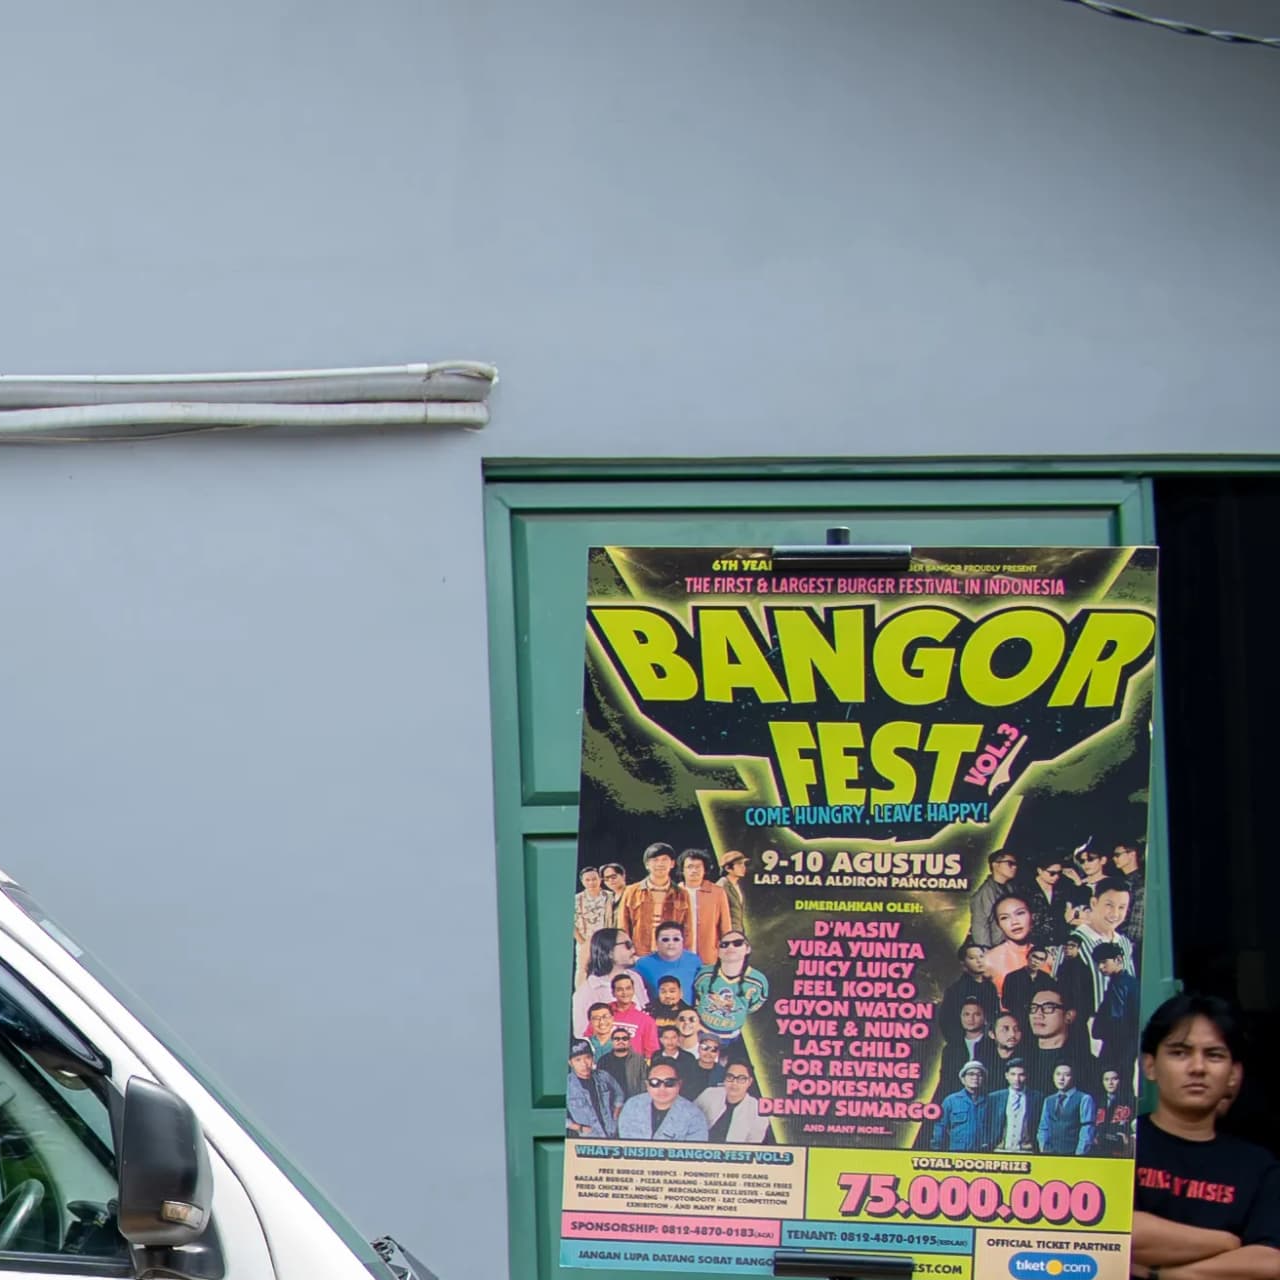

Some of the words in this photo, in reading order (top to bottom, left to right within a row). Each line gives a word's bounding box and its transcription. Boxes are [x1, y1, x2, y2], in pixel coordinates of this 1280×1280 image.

[712, 560, 738, 571] 6TH
[741, 560, 772, 571] YEA
[926, 564, 961, 573] BANGOR
[964, 564, 1000, 573] PROUDLY
[1003, 564, 1038, 573] PRESENT
[685, 577, 710, 593] THE
[714, 577, 753, 593] FIRST
[757, 577, 768, 593] &
[772, 577, 834, 593] LARGEST
[837, 577, 895, 594] BURGER
[899, 578, 961, 594] FESTIVAL
[965, 578, 980, 594] IN
[984, 579, 1065, 595] INDONESIA
[591, 608, 1156, 708] BANGOR
[964, 723, 1020, 787] VOL.3
[769, 721, 984, 813] FEST
[745, 808, 790, 826] COME
[795, 806, 871, 825] HUNGRY,
[875, 803, 922, 823] LEAVE
[927, 802, 989, 822] HAPPY!
[761, 850, 824, 873] 9-10
[831, 852, 961, 875] AGUSTUS
[754, 874, 782, 886] LAP.
[785, 875, 821, 887] BOLA
[825, 875, 888, 888] ALDIRON
[891, 877, 968, 889] PANCORAN
[795, 900, 883, 912] DIMERIAHKAN
[886, 902, 923, 913] OLEH:
[815, 921, 900, 938] D'MASIV
[787, 940, 843, 957] YURA
[848, 941, 925, 959] YUNITA
[796, 960, 851, 977] JUICY
[856, 961, 915, 979] LUICY
[793, 980, 836, 996] FEEL
[842, 981, 915, 999] KOPLO
[774, 1000, 849, 1017] GUYON
[855, 1001, 932, 1019] WATON
[776, 1019, 838, 1036] YOVIE
[843, 1021, 858, 1037] &
[865, 1022, 929, 1039] NUNO
[793, 1039, 843, 1056] LAST
[849, 1041, 911, 1058] CHILD
[782, 1059, 823, 1076] FOR
[829, 1060, 921, 1079] REVENGE
[787, 1079, 914, 1098] PODKESMAS
[758, 1098, 830, 1116] DENNY
[835, 1100, 941, 1120] SUMARGO
[803, 1124, 825, 1133] AND
[827, 1124, 855, 1134] MANY
[576, 1145, 620, 1157] WHAT'S
[623, 1146, 665, 1158] INSIDE
[668, 1148, 721, 1160] BANGOR
[724, 1150, 752, 1161] FEST
[912, 1158, 952, 1169] TOTAL
[955, 1159, 1030, 1172] DOORPRIZE
[664, 1195, 716, 1203] PHOTOBOOTH
[838, 1173, 1104, 1224] 75.000.000
[570, 1221, 658, 1234] SPONSORSHIP:
[787, 1230, 836, 1241] TENANT:
[987, 1238, 1033, 1249] OFFICIAL
[1036, 1240, 1070, 1250] TICKET
[1073, 1242, 1121, 1252] PARTNER
[578, 1250, 621, 1261] JANGAN
[623, 1252, 649, 1262] LUPA
[653, 1253, 695, 1264] DATANG
[698, 1256, 732, 1265] SOBAT
[735, 1257, 774, 1267] BANGO
